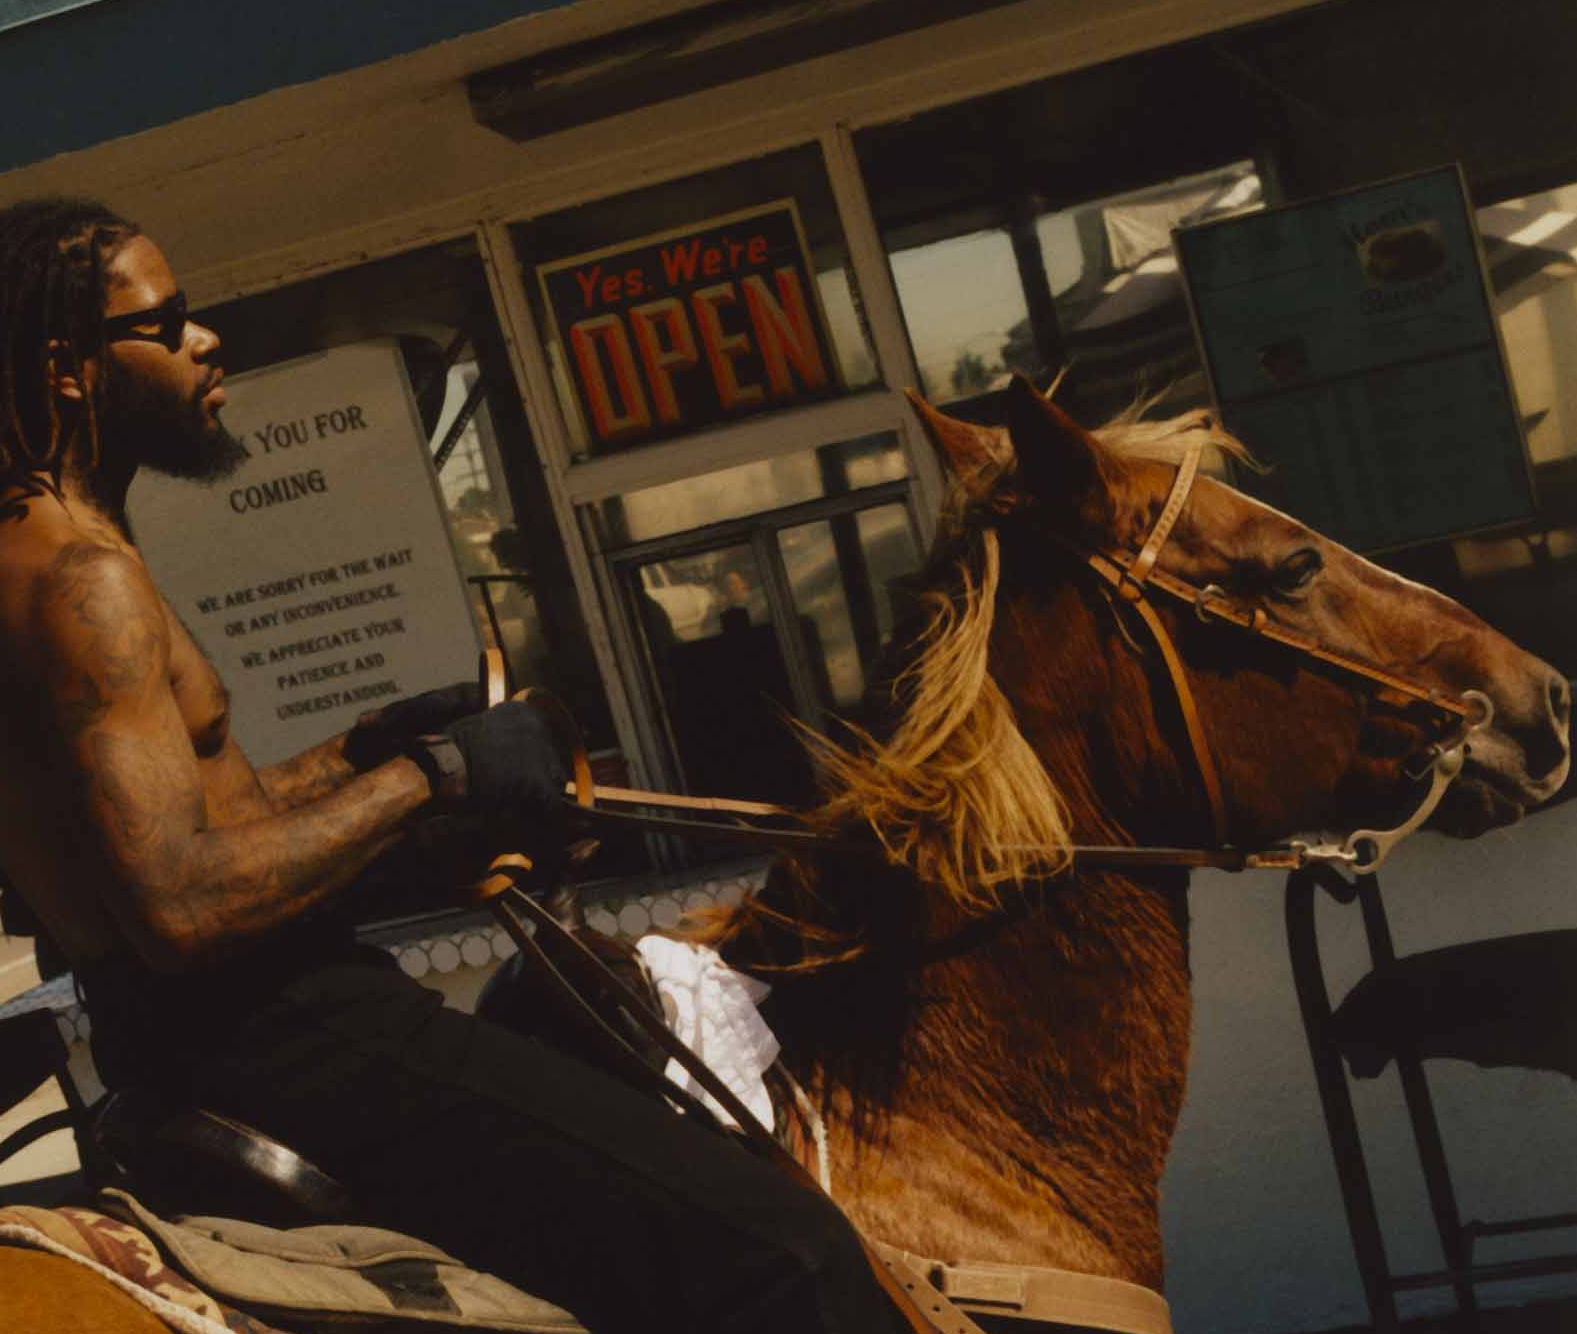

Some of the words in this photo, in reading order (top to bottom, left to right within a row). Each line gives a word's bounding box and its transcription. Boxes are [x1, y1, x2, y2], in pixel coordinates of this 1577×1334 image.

[660, 234, 768, 285] We're
[569, 266, 827, 438] OPEN
[255, 419, 309, 455] YOU
[314, 405, 367, 440] FOR
[229, 469, 327, 515] COMING
[197, 596, 223, 614] WE
[225, 588, 256, 608] ARE
[257, 574, 305, 599] SORRY
[309, 566, 340, 588] FOR
[373, 548, 413, 571] WAIT
[241, 651, 266, 669] WE
[268, 627, 361, 665] APPRECIATE
[364, 618, 406, 639] YOUR
[249, 612, 279, 632] ANY
[276, 661, 351, 691] PATIENCE
[355, 652, 385, 672] AND
